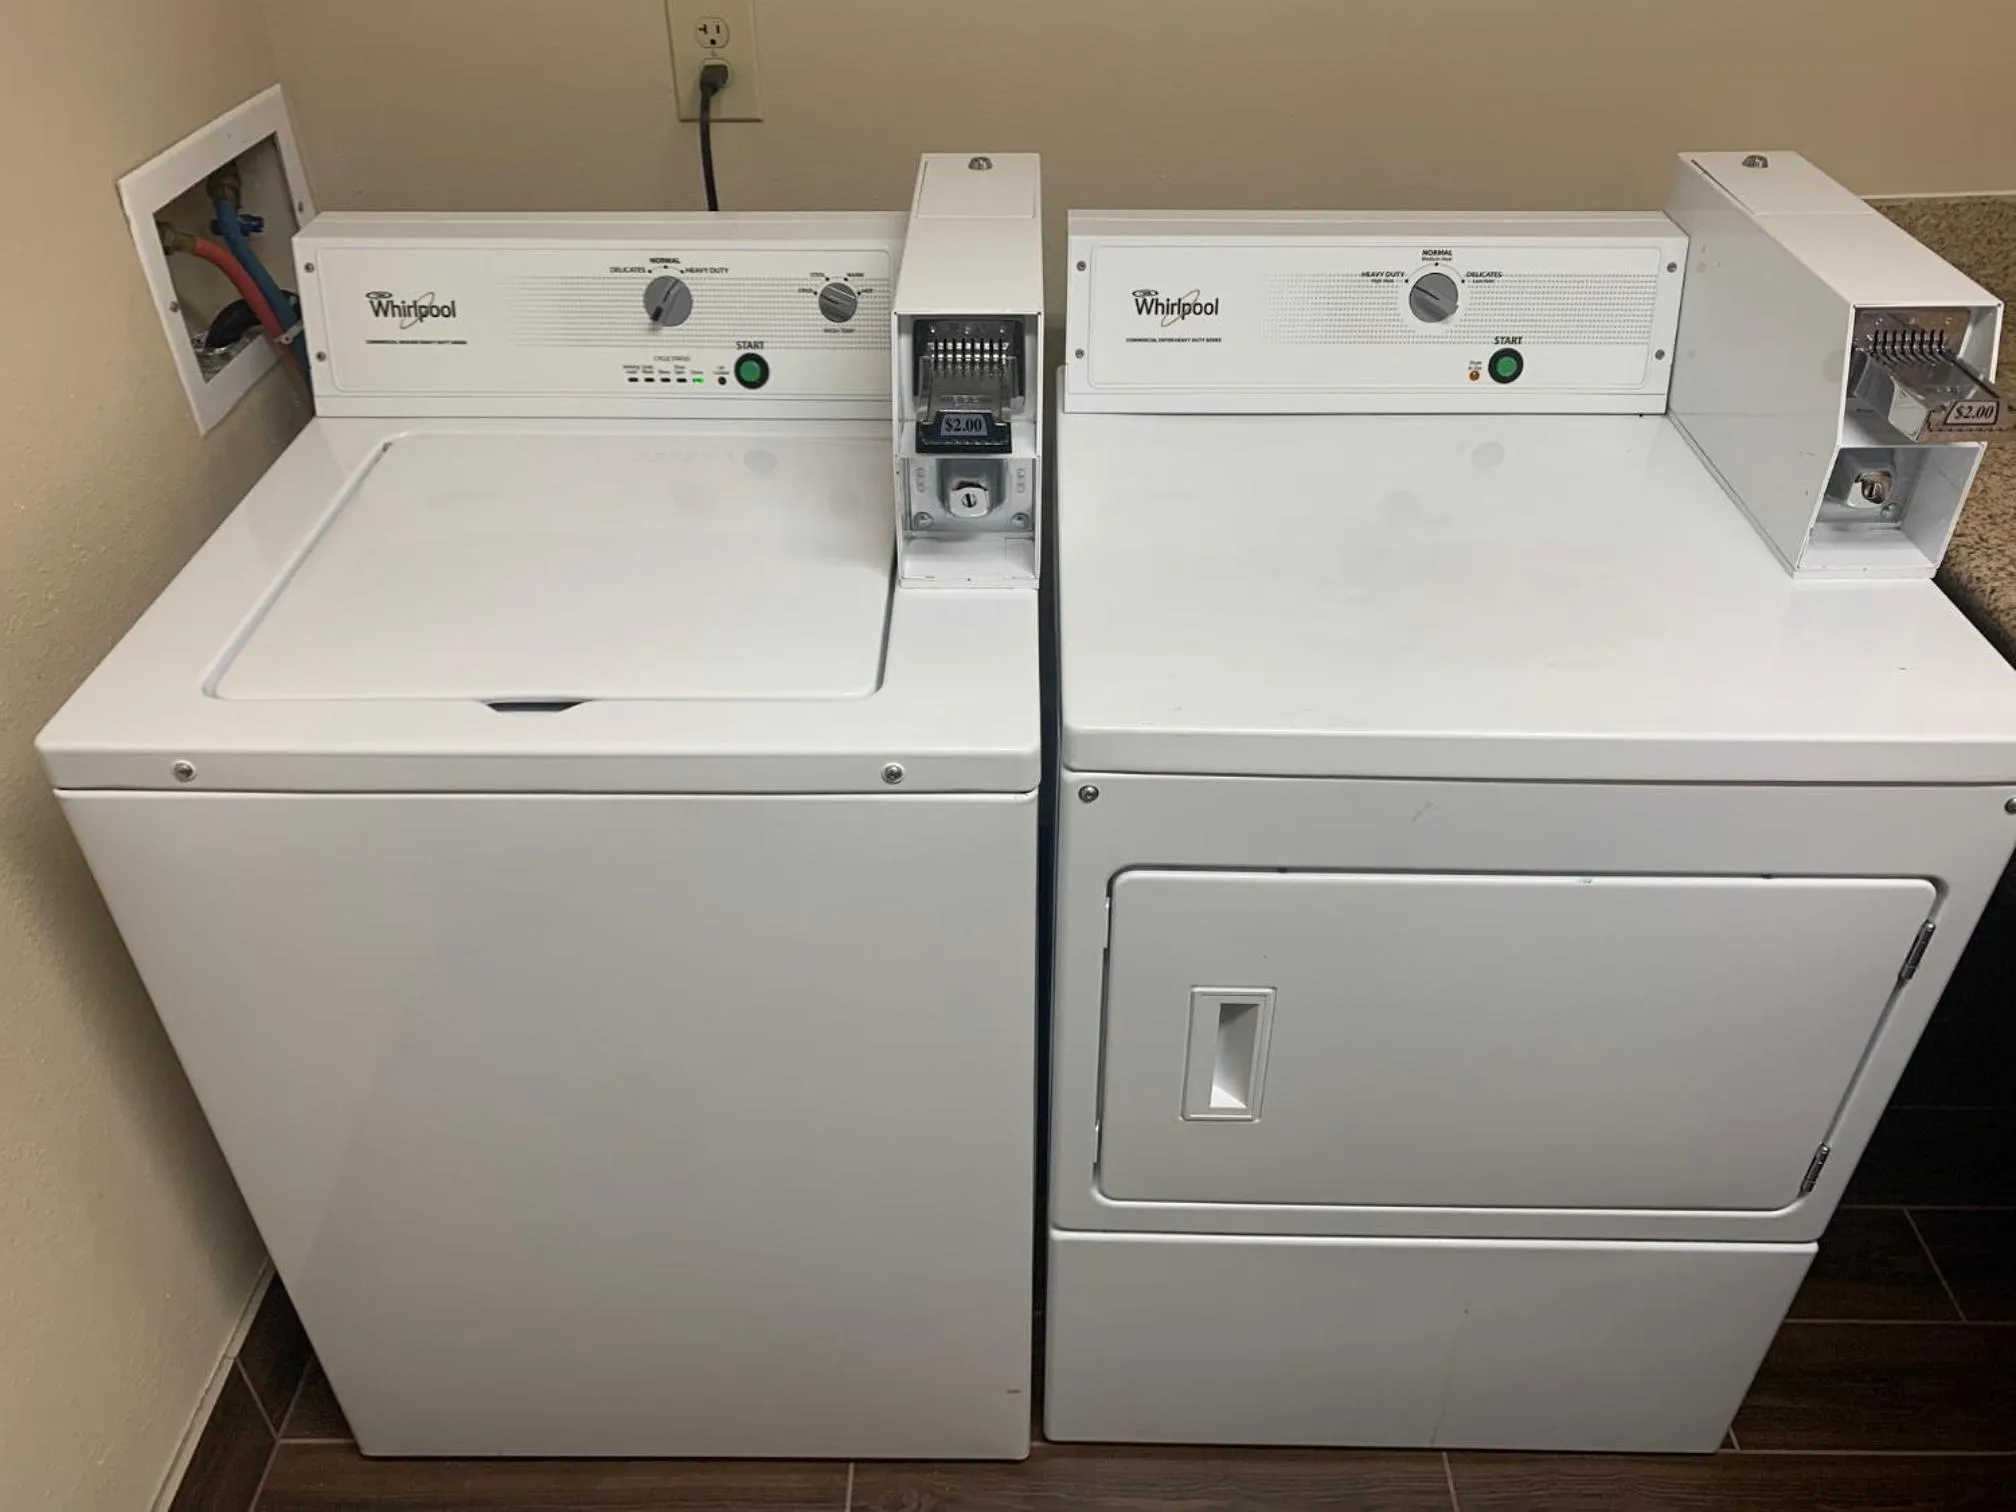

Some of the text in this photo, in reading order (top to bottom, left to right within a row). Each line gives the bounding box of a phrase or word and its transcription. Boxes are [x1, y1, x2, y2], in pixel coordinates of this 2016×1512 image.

[368, 299, 457, 323] Whirlpool
[1134, 297, 1219, 321] Whirlpool
[735, 341, 765, 350] START
[1494, 336, 1523, 345] START
[1954, 405, 1994, 420] $2.00
[944, 417, 982, 433] $2.00
